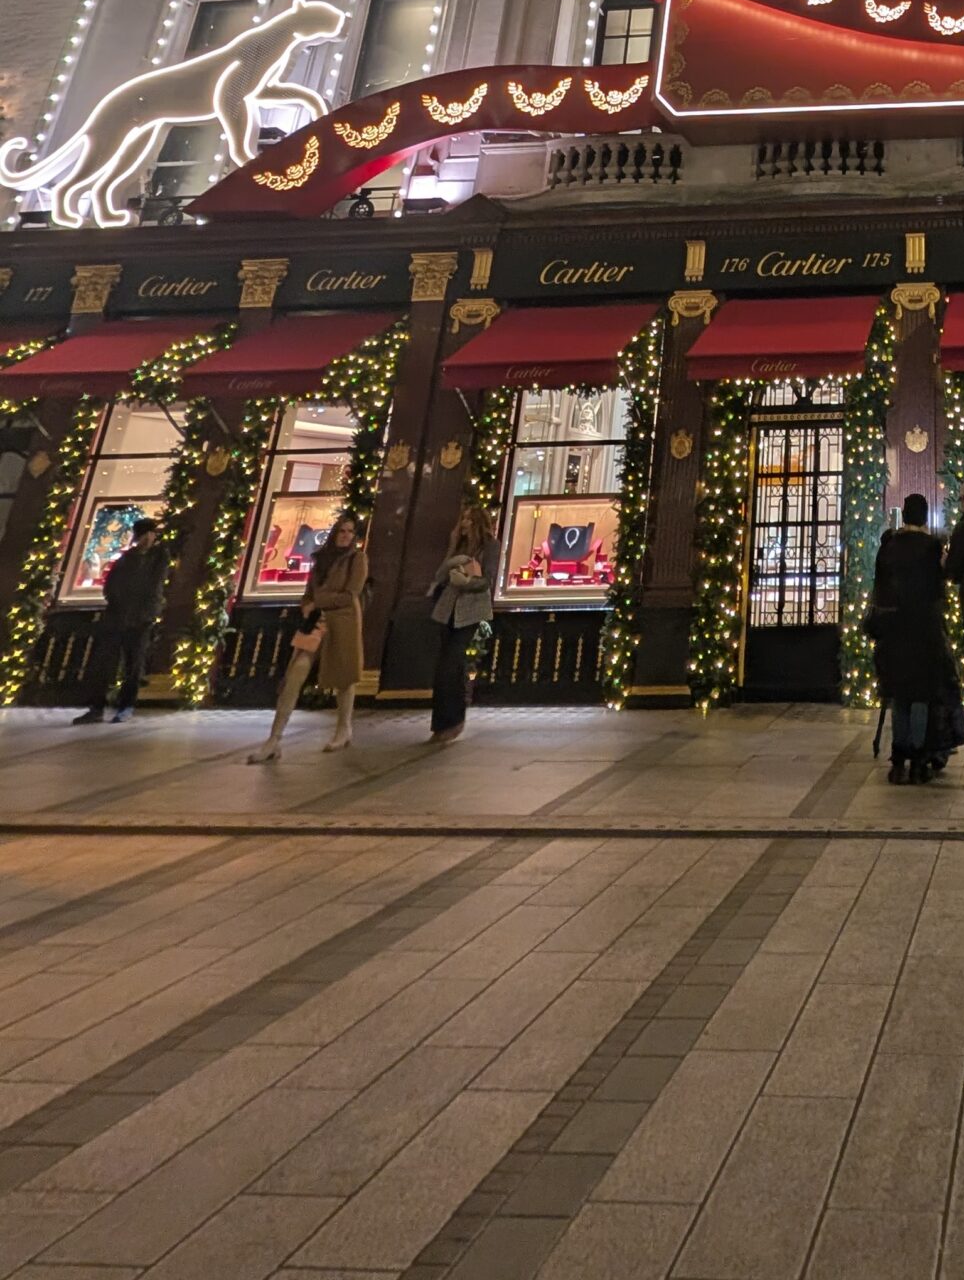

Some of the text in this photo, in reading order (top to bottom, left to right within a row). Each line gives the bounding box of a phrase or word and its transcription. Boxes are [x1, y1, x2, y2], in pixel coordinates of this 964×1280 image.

[538, 258, 635, 286] Cartier
[720, 250, 892, 278] 176 Cartier 175
[137, 273, 218, 298] Cartier
[306, 268, 387, 293] Cartier
[24, 286, 53, 303] 177
[505, 365, 554, 380] Cartier
[751, 358, 800, 373] Cartier
